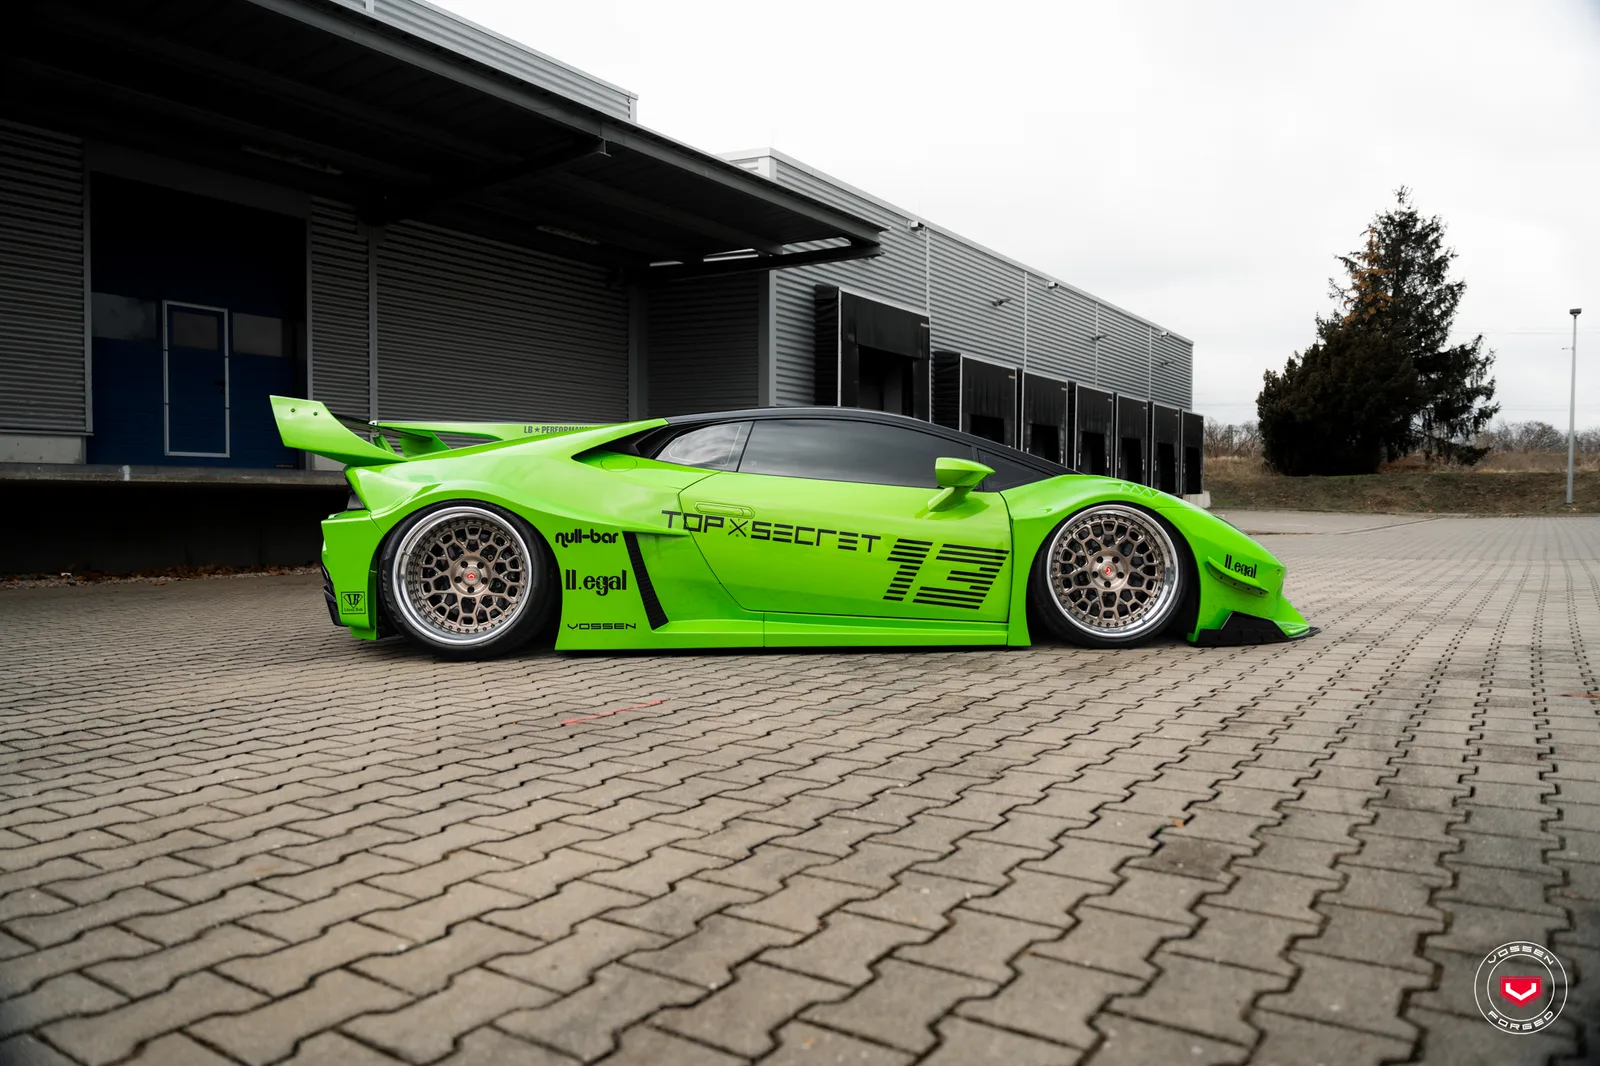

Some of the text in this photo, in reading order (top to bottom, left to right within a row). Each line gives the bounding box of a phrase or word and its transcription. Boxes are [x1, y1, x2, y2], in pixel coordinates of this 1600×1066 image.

[524, 425, 533, 434] LB
[661, 510, 724, 533] TOP
[555, 528, 619, 548] null-bar
[882, 538, 1010, 610] 13
